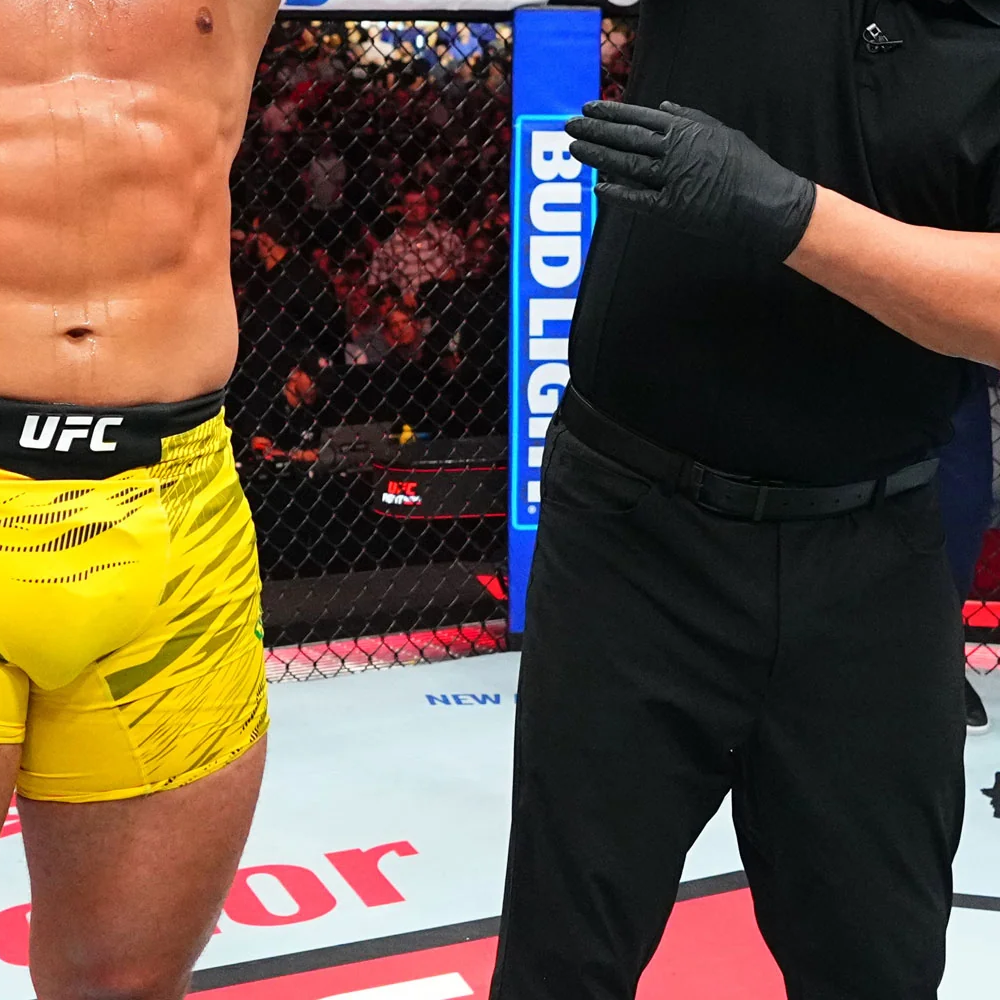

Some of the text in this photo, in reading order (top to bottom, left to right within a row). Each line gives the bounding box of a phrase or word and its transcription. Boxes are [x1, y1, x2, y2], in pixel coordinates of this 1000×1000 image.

[526, 130, 582, 503] BUD LIG
[19, 415, 124, 452] UFC
[425, 693, 501, 706] NEW
